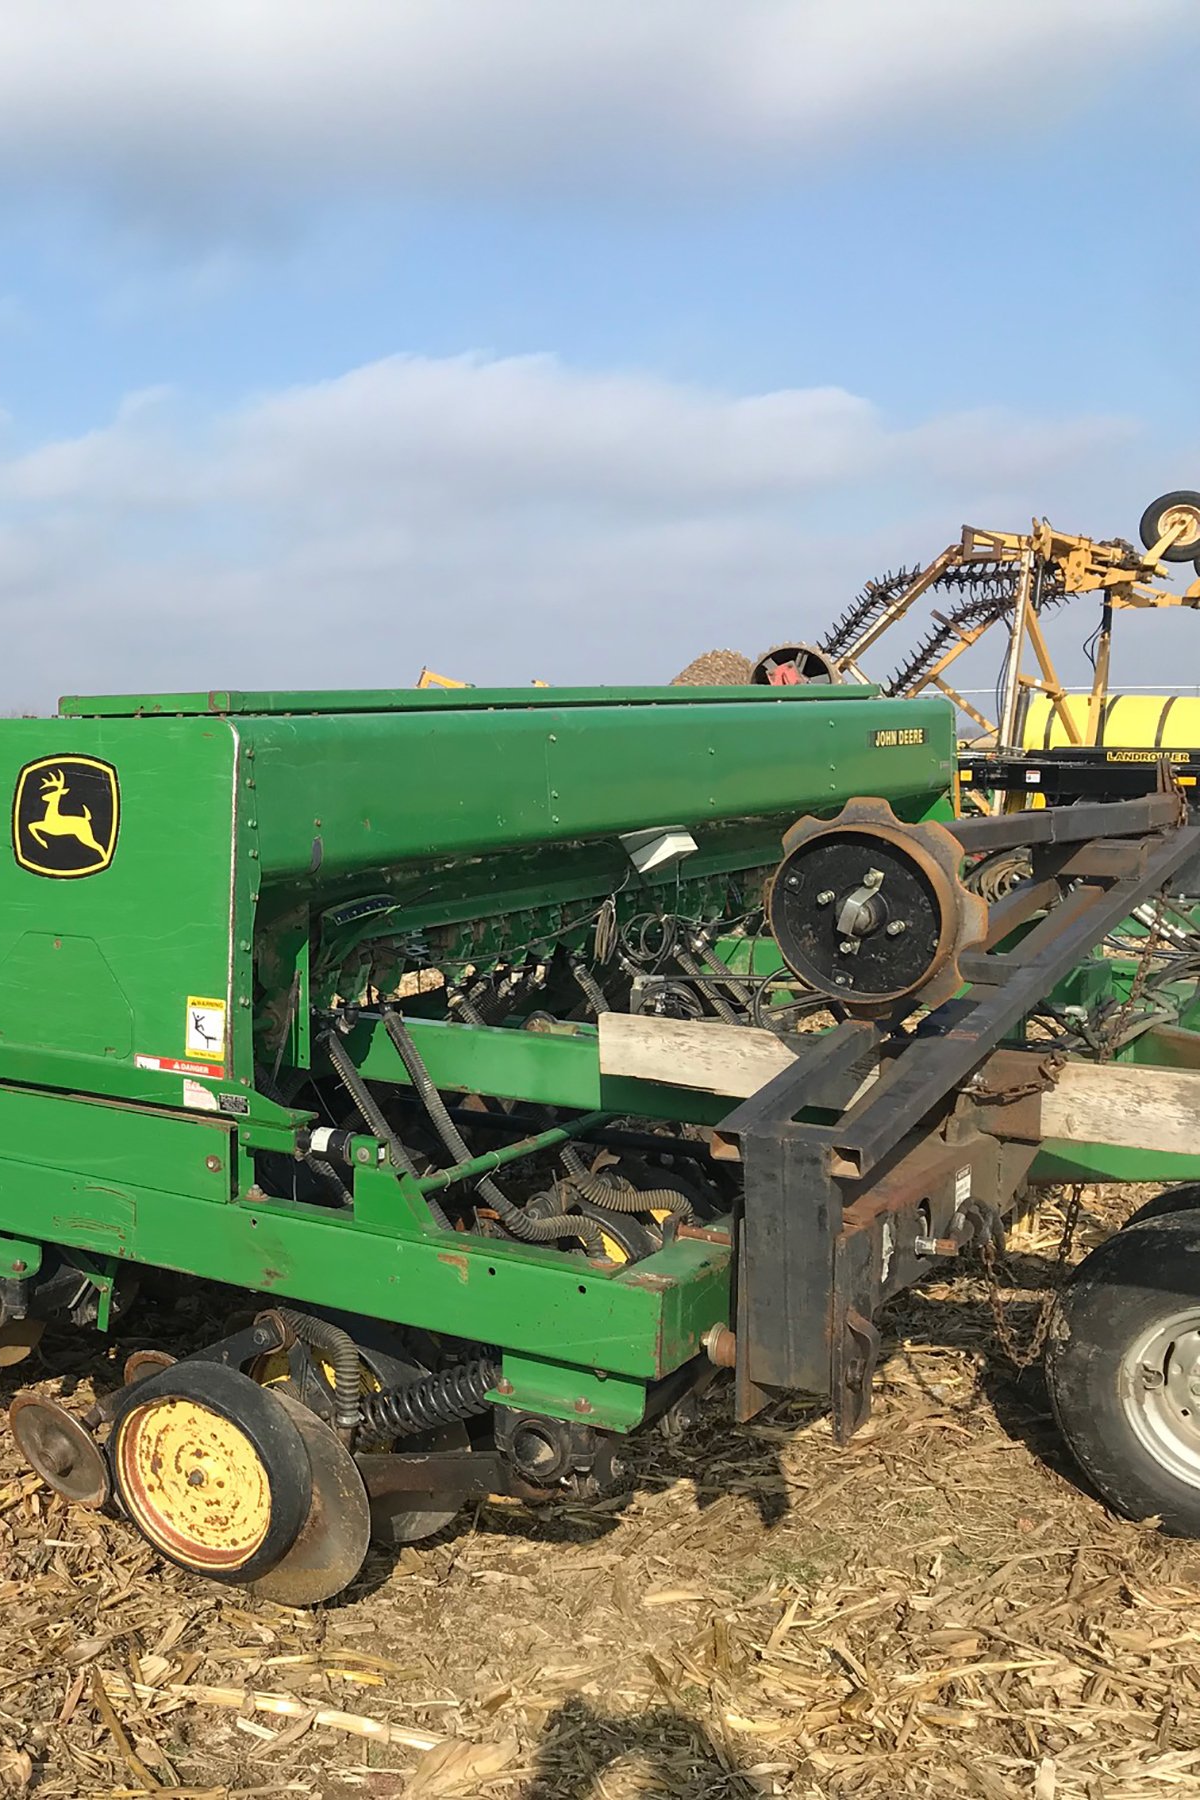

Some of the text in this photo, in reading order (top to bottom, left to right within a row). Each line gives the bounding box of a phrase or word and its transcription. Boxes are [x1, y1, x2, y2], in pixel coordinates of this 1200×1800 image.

[876, 729, 923, 746] JOHN DEERE
[180, 1063, 209, 1074] DANGER
